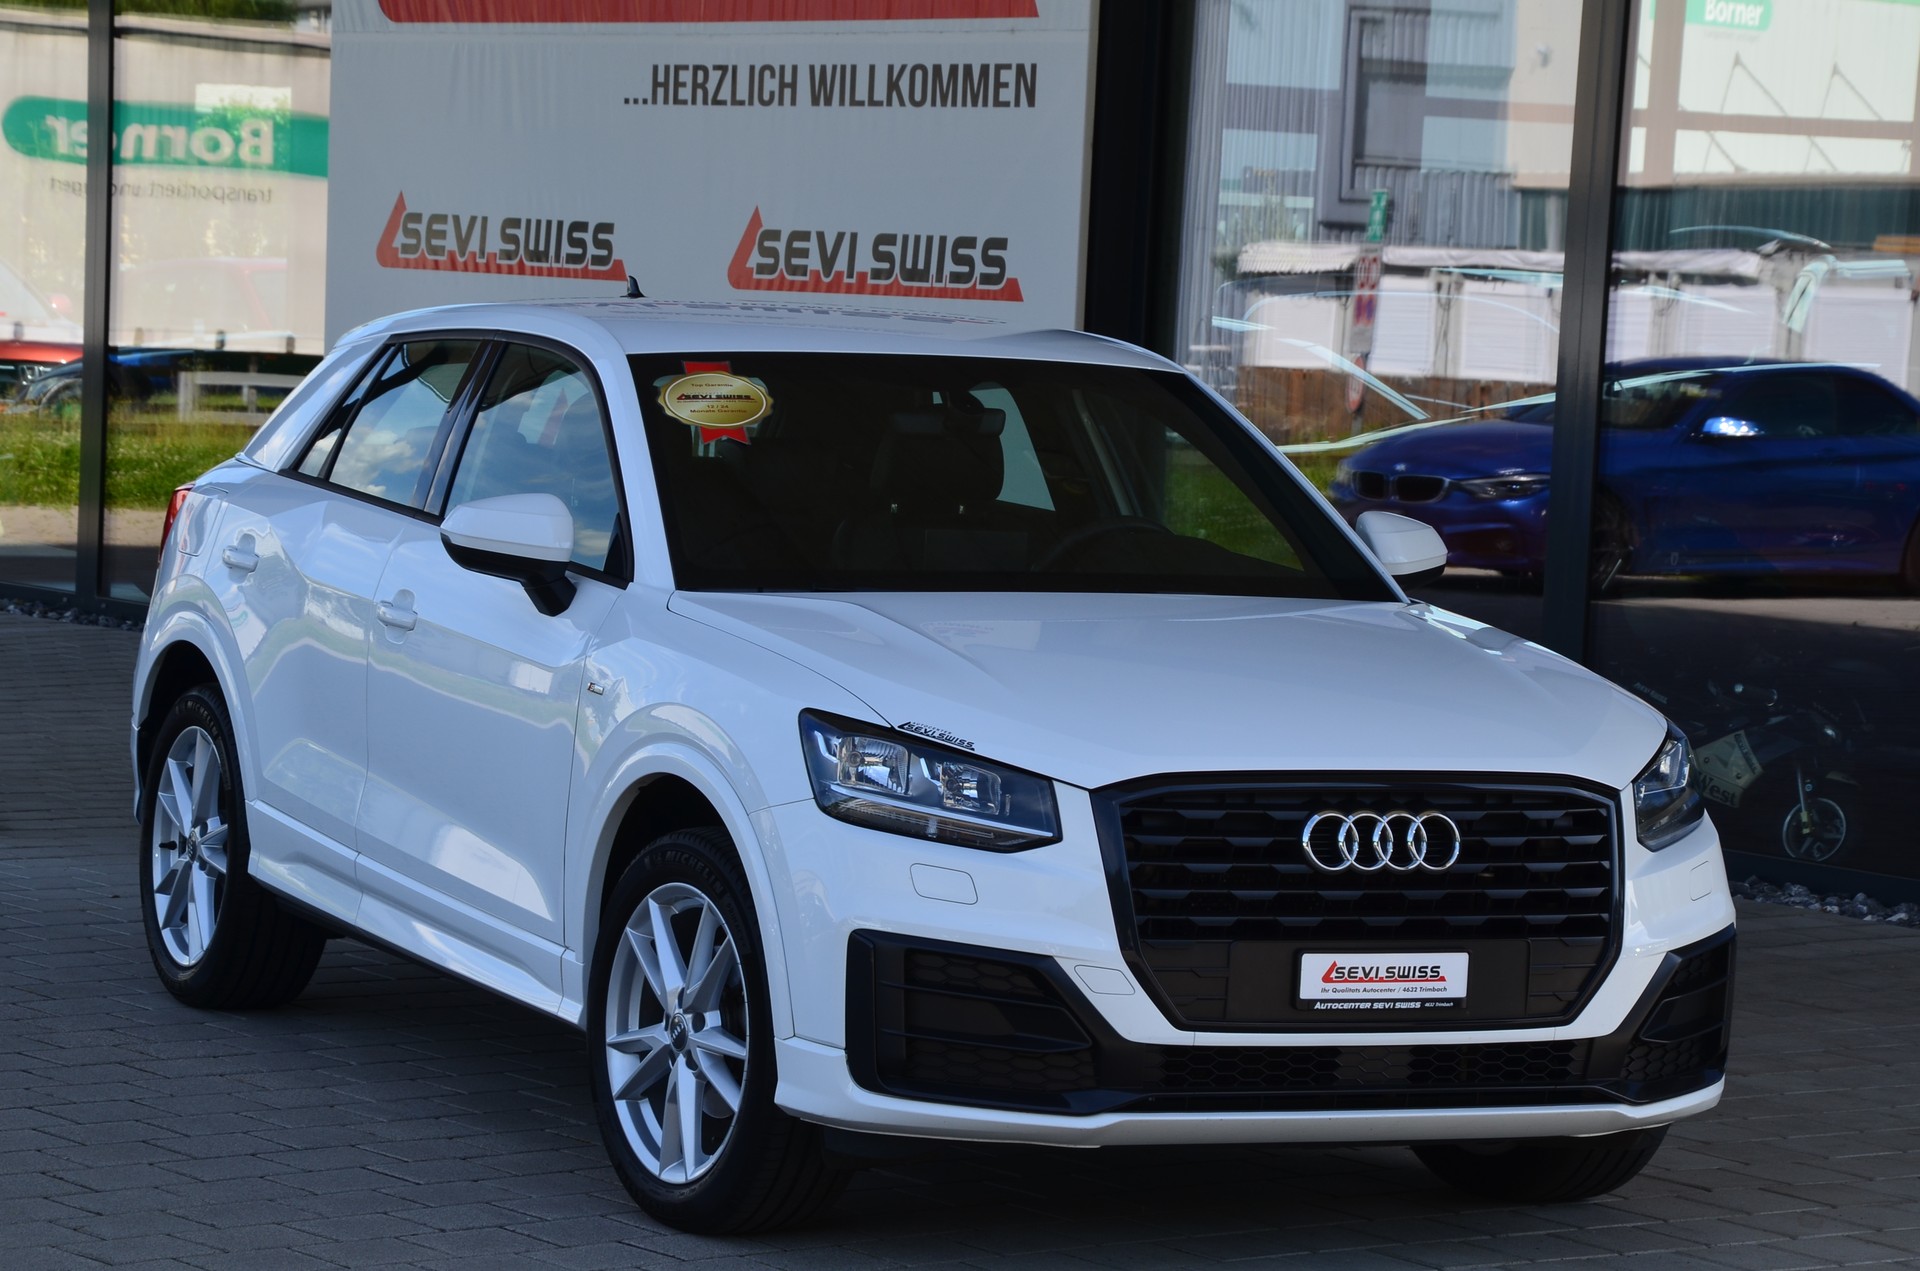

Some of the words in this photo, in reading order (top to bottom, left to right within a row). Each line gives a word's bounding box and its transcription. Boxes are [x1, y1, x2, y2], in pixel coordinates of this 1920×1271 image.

[1704, 0, 1764, 27] Borner
[808, 63, 1038, 108] WILLKOMMEN
[401, 211, 488, 263] SEVI
[498, 217, 616, 270] SWISS
[755, 228, 859, 283] SEVI
[870, 232, 1009, 287] SWISS
[906, 723, 936, 737] SEVI
[936, 732, 975, 748] SWISS
[664, 850, 725, 896] MICHELIN
[1334, 965, 1379, 979] SEVI
[1384, 964, 1441, 979] SWISS
[1419, 985, 1448, 993] Trimbach
[1372, 1001, 1394, 1009] SEVI
[1394, 1001, 1422, 1009] SWISS
